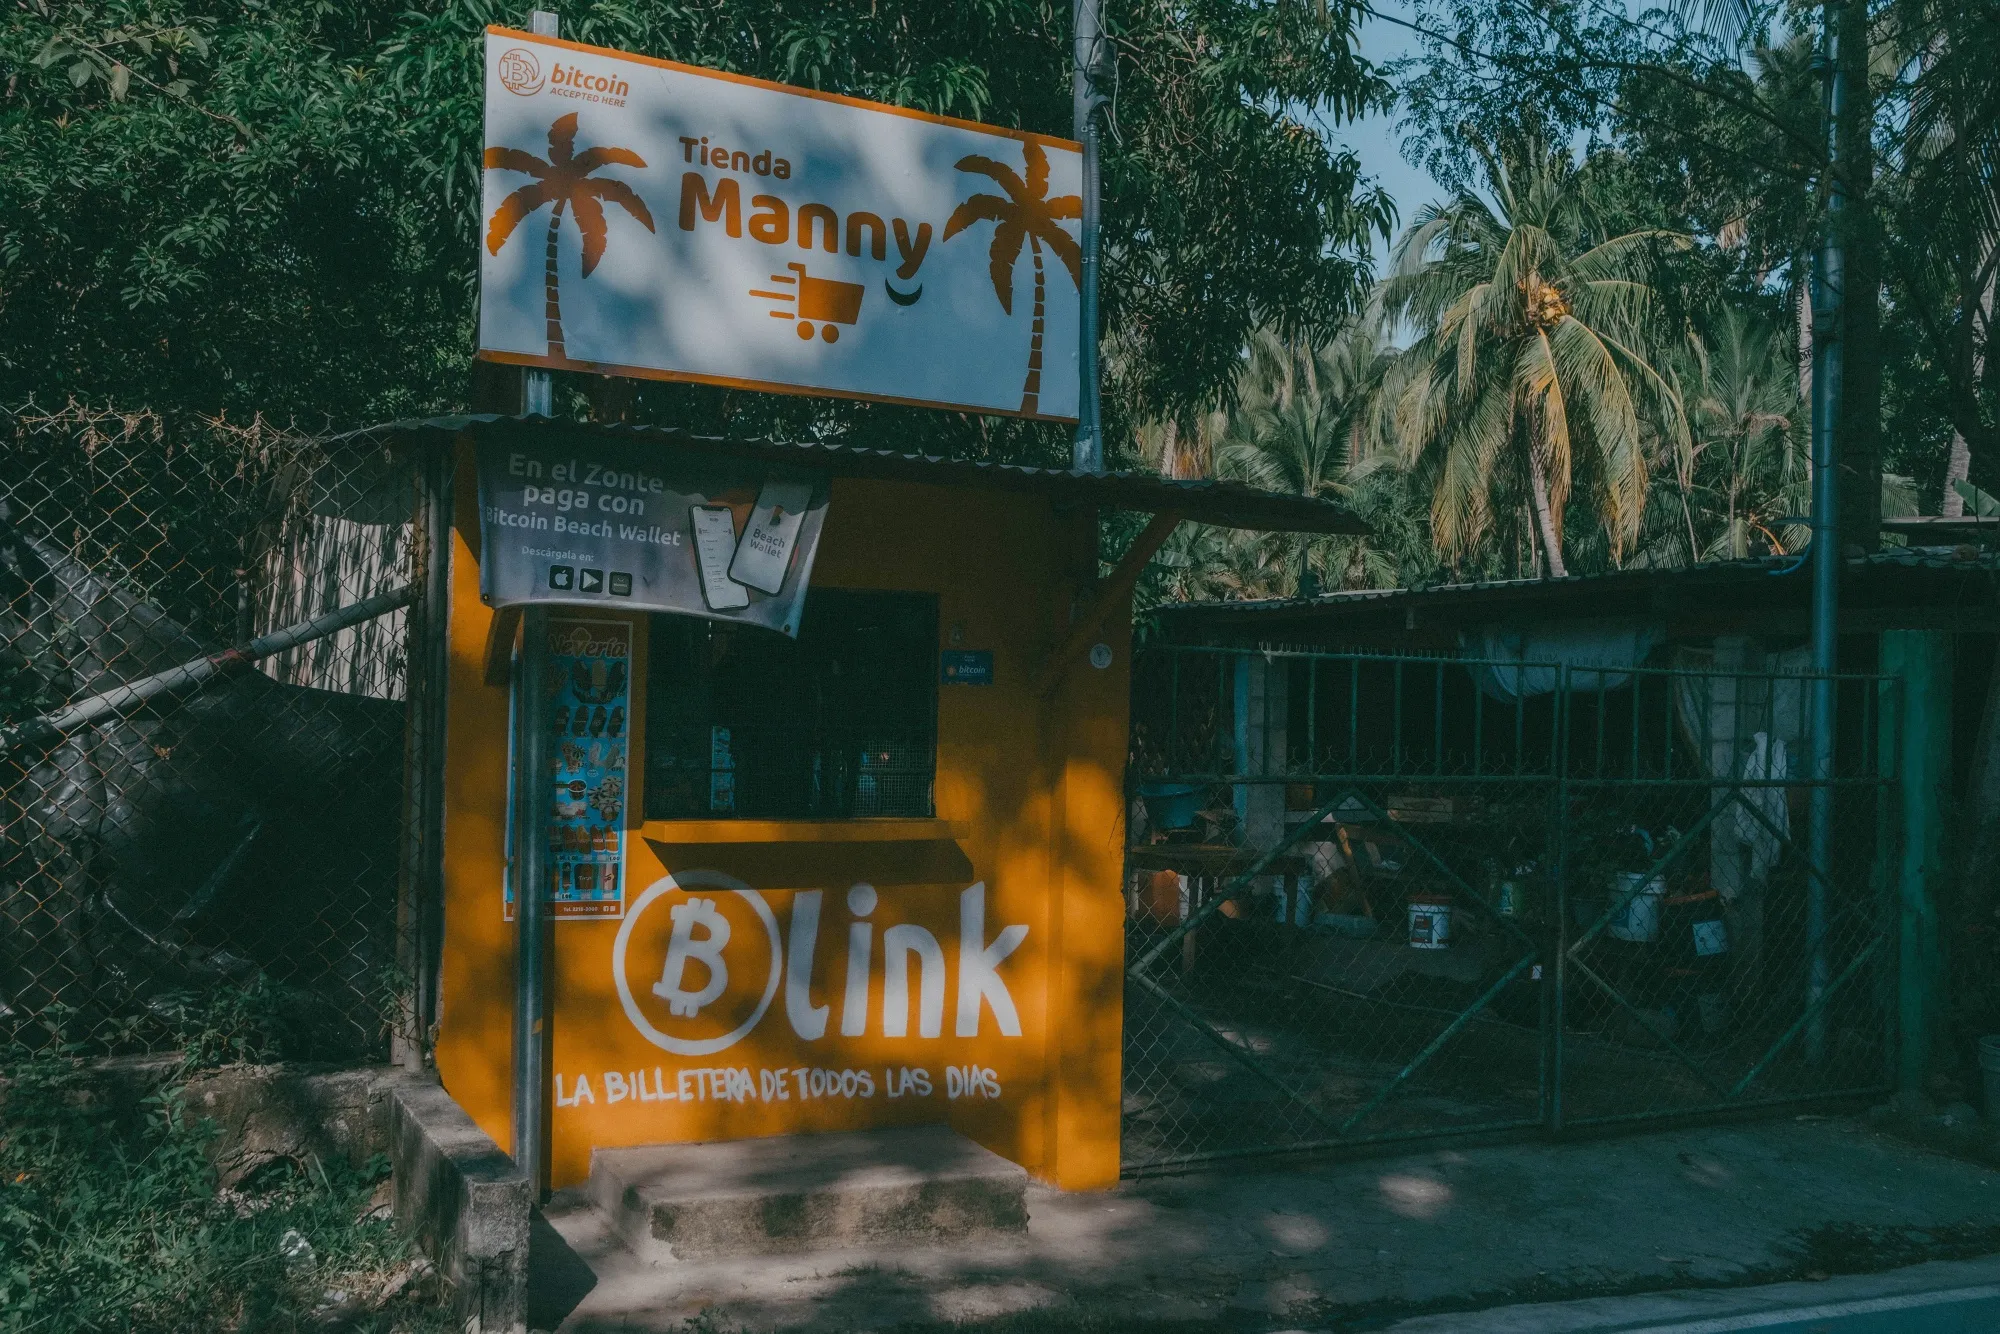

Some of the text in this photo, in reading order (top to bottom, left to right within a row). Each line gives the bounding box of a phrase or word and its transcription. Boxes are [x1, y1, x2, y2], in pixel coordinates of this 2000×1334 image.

[551, 63, 629, 97] bitcoin
[550, 87, 626, 108] ACCEPTED HERE
[679, 136, 791, 180] Tienda
[678, 171, 933, 280] Manny
[508, 453, 664, 494] En el Zonte
[524, 485, 645, 516] paga con
[486, 506, 681, 547] Bitcoin Beach Wallet
[753, 528, 785, 549] Beach
[579, 552, 595, 562] en:
[750, 539, 782, 559] Wallet
[958, 665, 986, 674] bitcoin
[555, 1063, 1002, 1108] LA BILLETERA DE TODOS LAS DIAS
